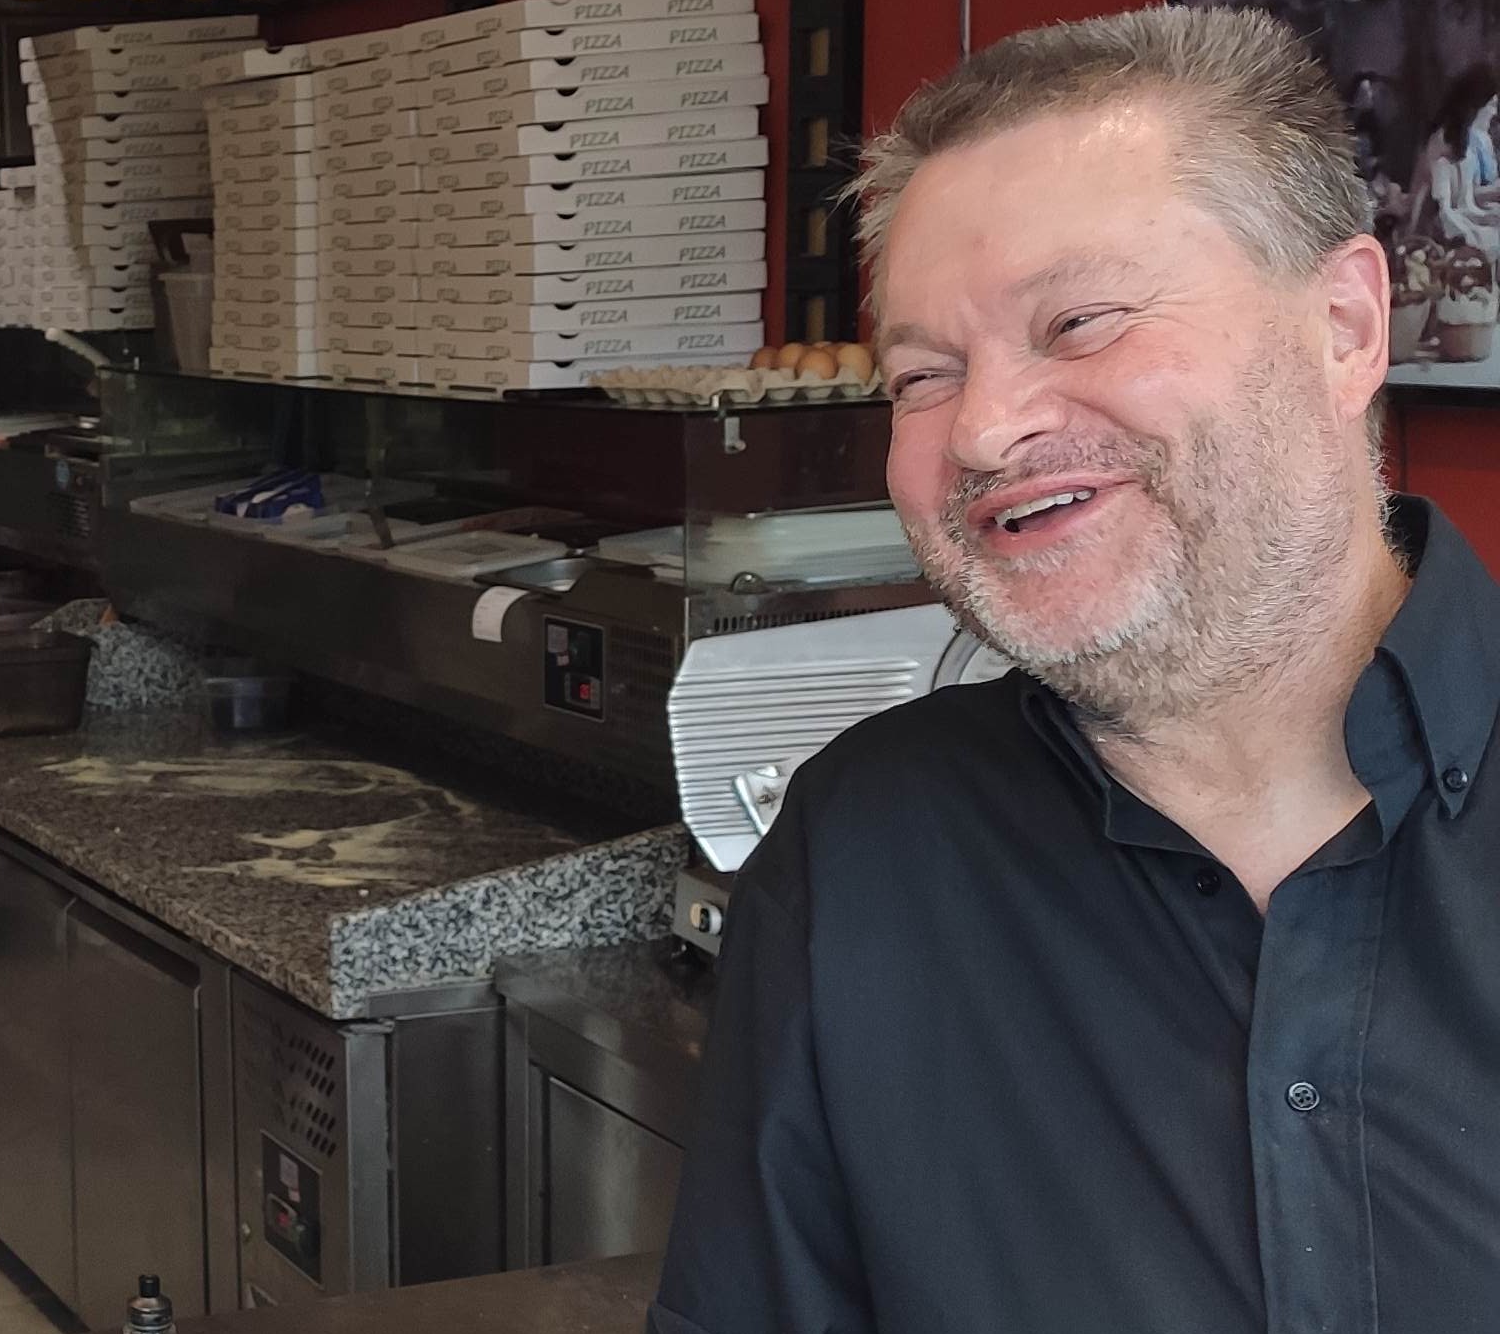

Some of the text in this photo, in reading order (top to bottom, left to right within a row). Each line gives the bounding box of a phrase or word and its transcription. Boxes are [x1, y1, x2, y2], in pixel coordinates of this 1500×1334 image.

[574, 3, 622, 19] PIZZA
[114, 32, 153, 44] PIZZA
[572, 27, 718, 51] PIZZA PIZZA
[129, 54, 166, 66] PIZZA
[580, 59, 724, 82] PIZZA PIZZA
[131, 76, 169, 88] PIZZA
[585, 90, 729, 113] PIZZA PIZZA
[569, 123, 717, 148] PIZZA PIZZA
[581, 152, 727, 176] PIZZA PIZZA
[575, 185, 721, 208] PIZZA PIZZA
[584, 215, 726, 236] PIZZA PIZZA
[585, 246, 726, 267] PIZZA PIZZA
[586, 273, 728, 295] PIZZA PIZZA
[580, 305, 721, 326] PIZZA PIZZA
[584, 334, 725, 355] PIZZA PIZZA
